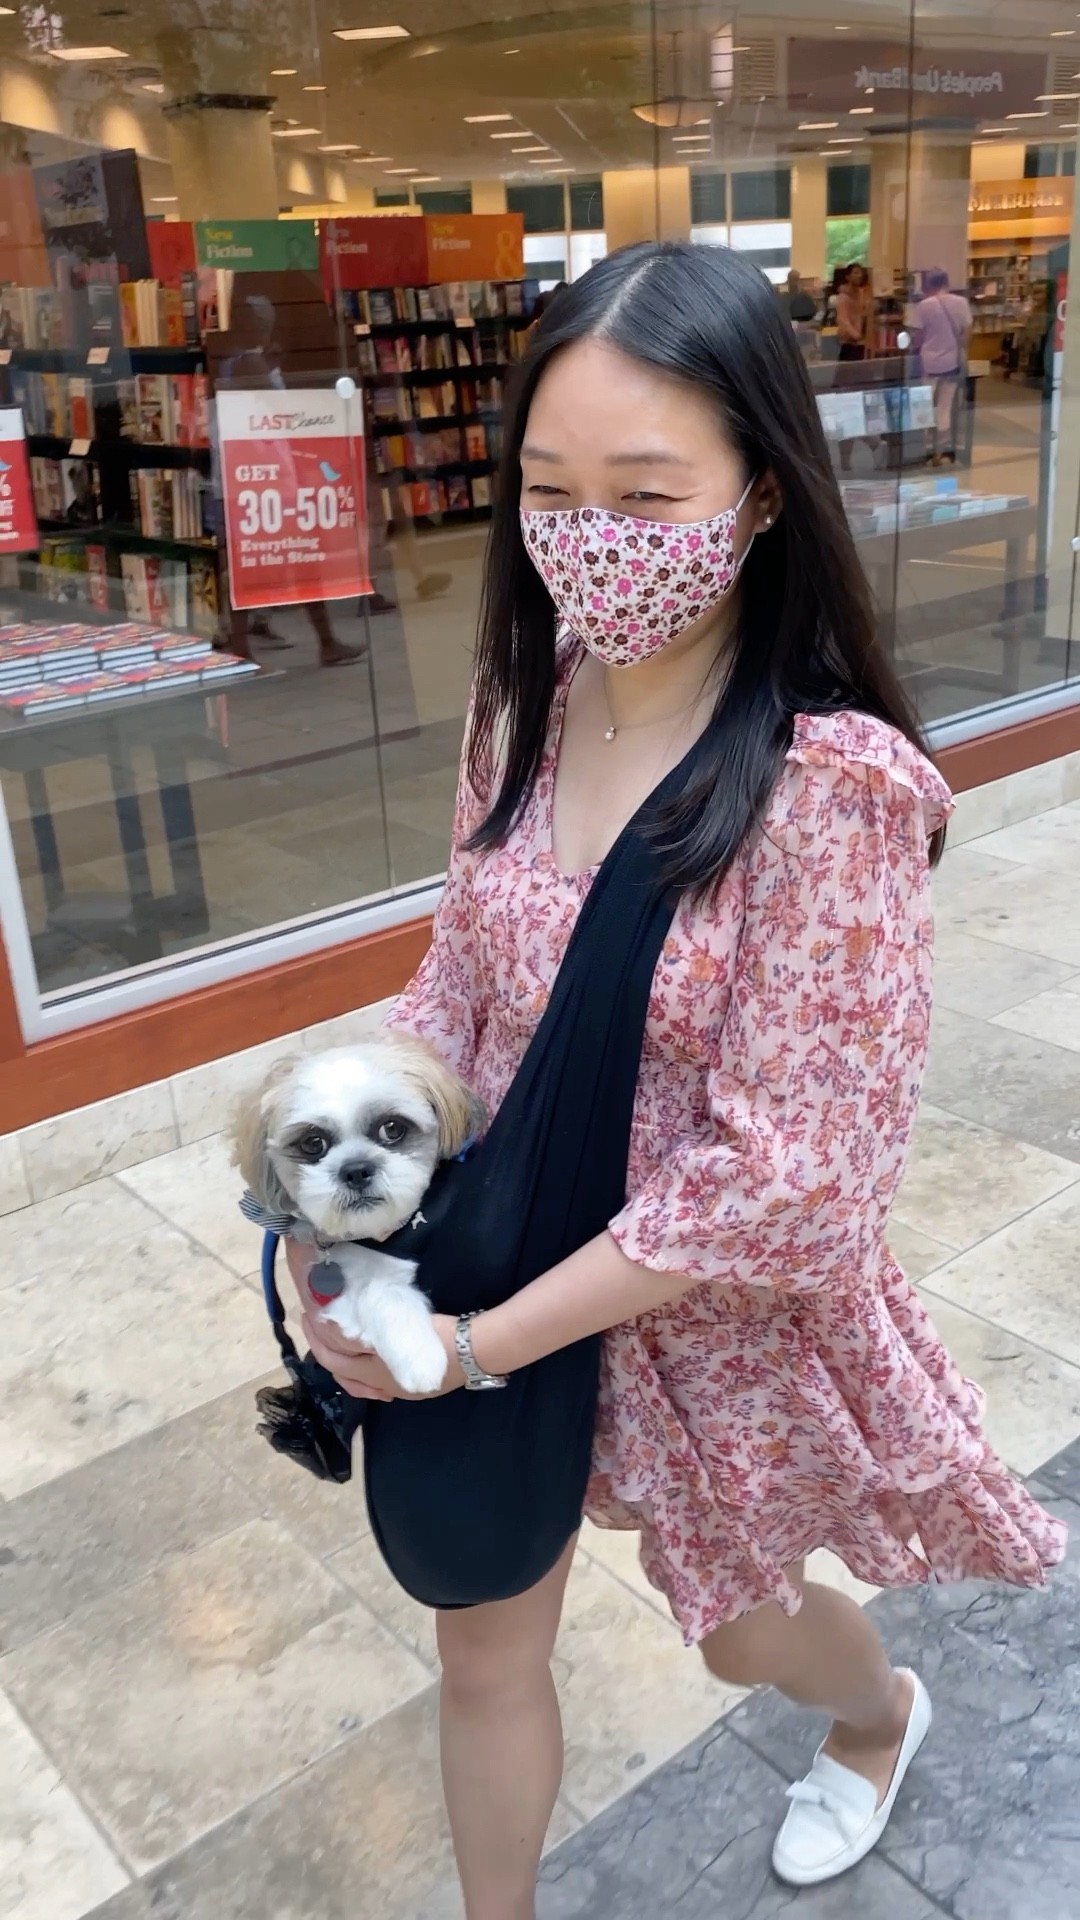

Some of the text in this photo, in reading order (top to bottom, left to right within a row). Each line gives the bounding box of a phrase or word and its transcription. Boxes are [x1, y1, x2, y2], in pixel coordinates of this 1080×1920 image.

[206, 245, 253, 258] Fiction
[432, 237, 471, 250] Fiction
[249, 414, 292, 431] LAST
[235, 464, 280, 482] GET
[339, 511, 356, 528] OFF
[240, 537, 319, 553] Everything
[241, 552, 326, 568] in the Store
